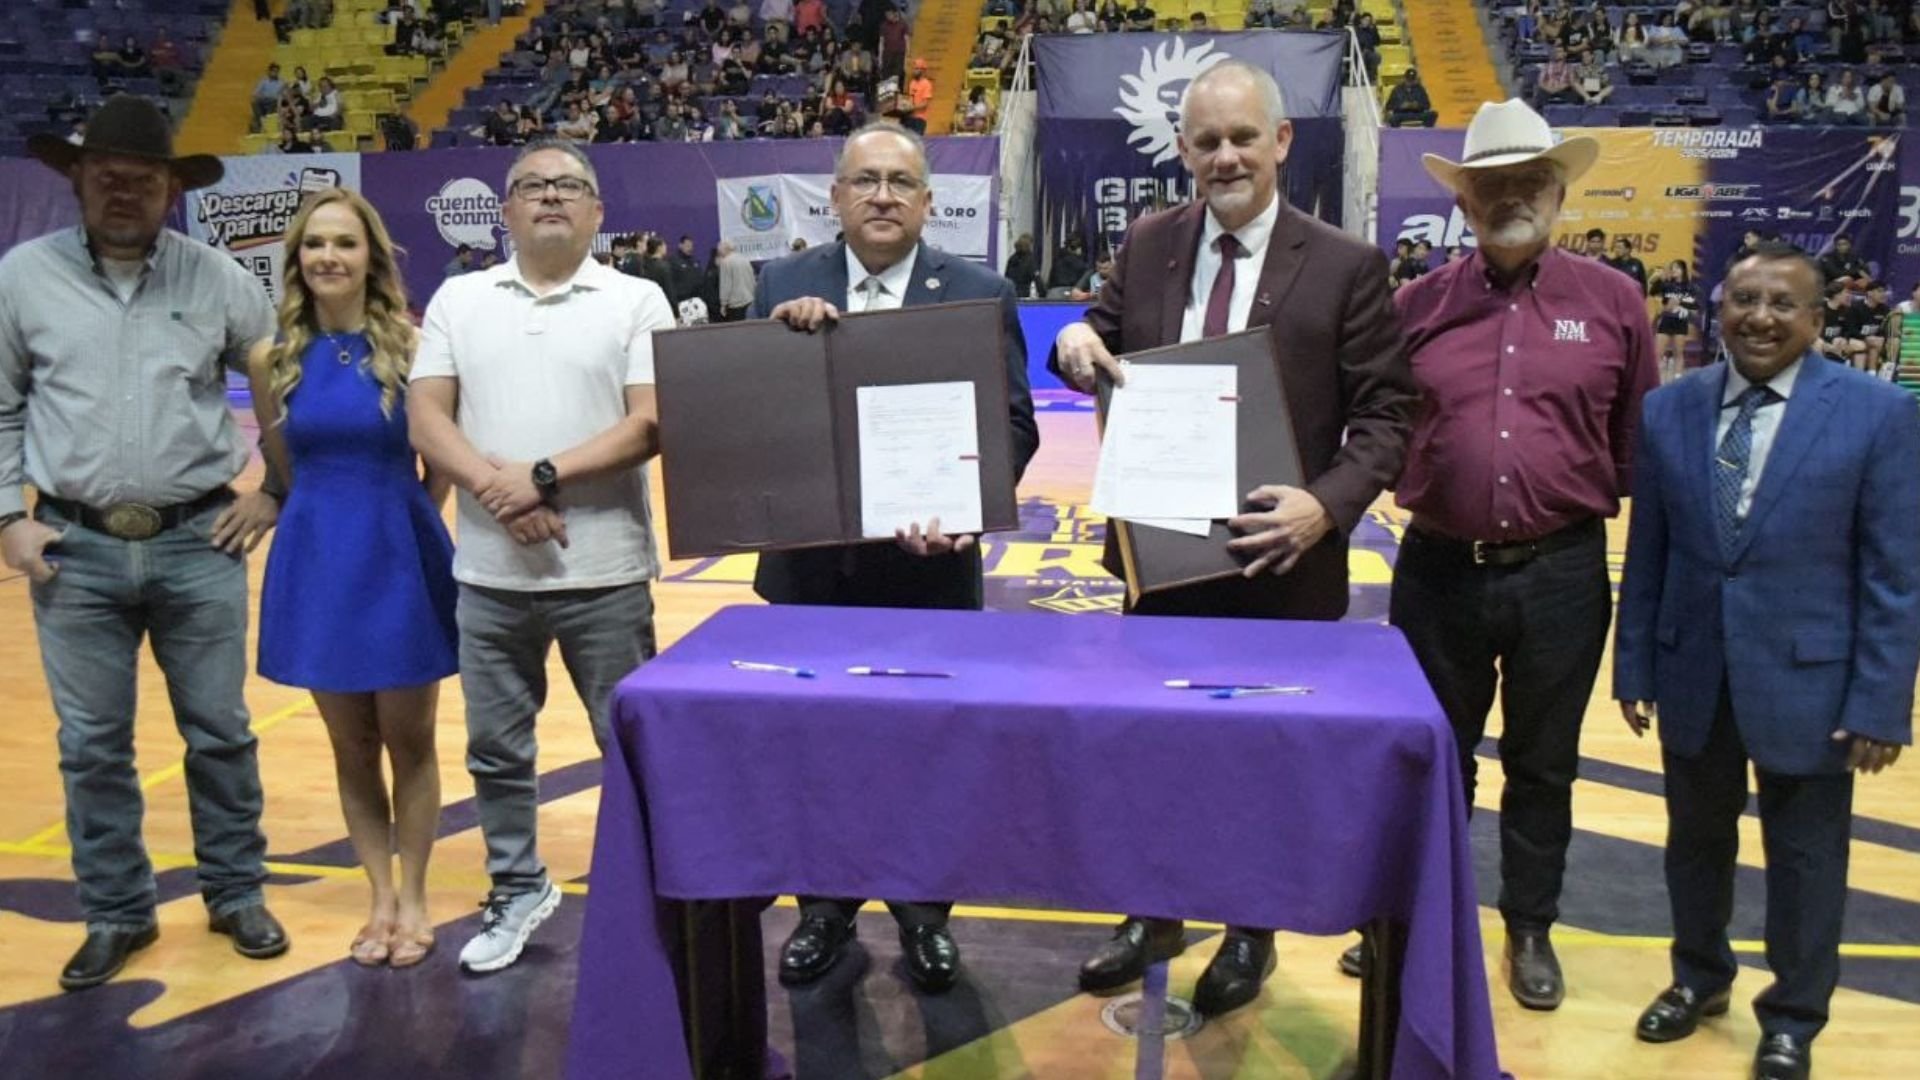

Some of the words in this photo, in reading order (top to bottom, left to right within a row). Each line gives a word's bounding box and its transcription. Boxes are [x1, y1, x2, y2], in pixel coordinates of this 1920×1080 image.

[1653, 129, 1762, 148] TEMPORADA
[1664, 187, 1699, 196] LIGA
[427, 193, 498, 212] cuenta
[943, 206, 976, 217] ORO
[224, 206, 295, 245] partici
